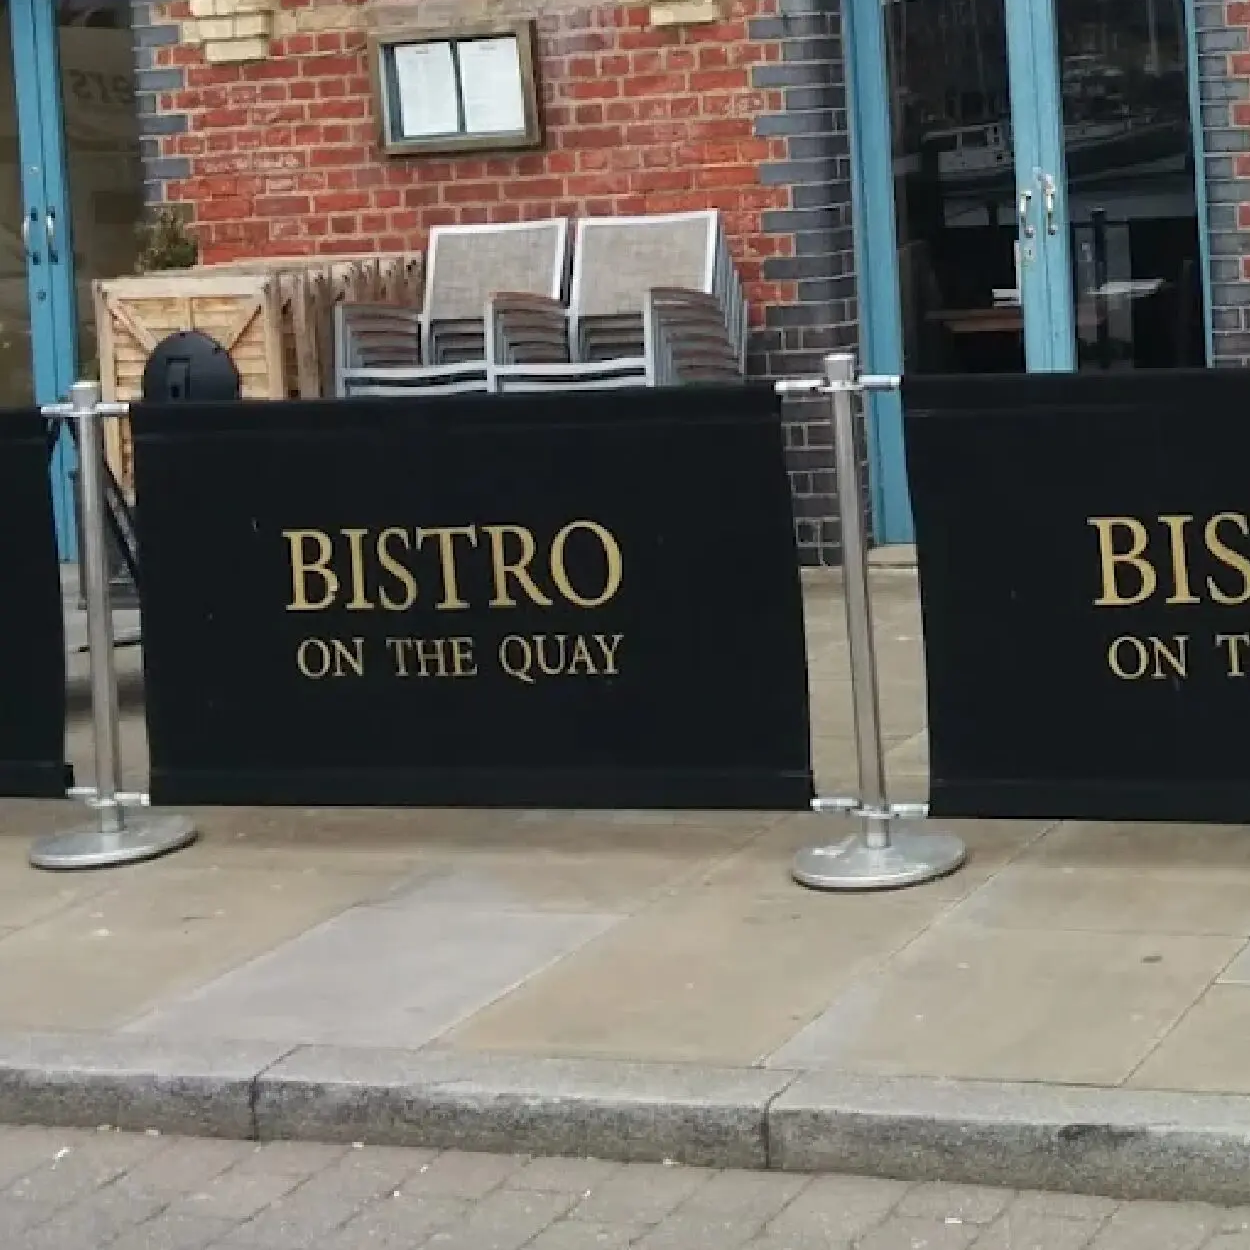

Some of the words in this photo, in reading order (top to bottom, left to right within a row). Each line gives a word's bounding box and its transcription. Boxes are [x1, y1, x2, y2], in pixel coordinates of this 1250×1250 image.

[283, 520, 622, 610] BISTRO
[298, 637, 365, 678] ON
[386, 637, 477, 677] THE
[499, 634, 624, 684] QUAY
[1109, 635, 1188, 679] ON
